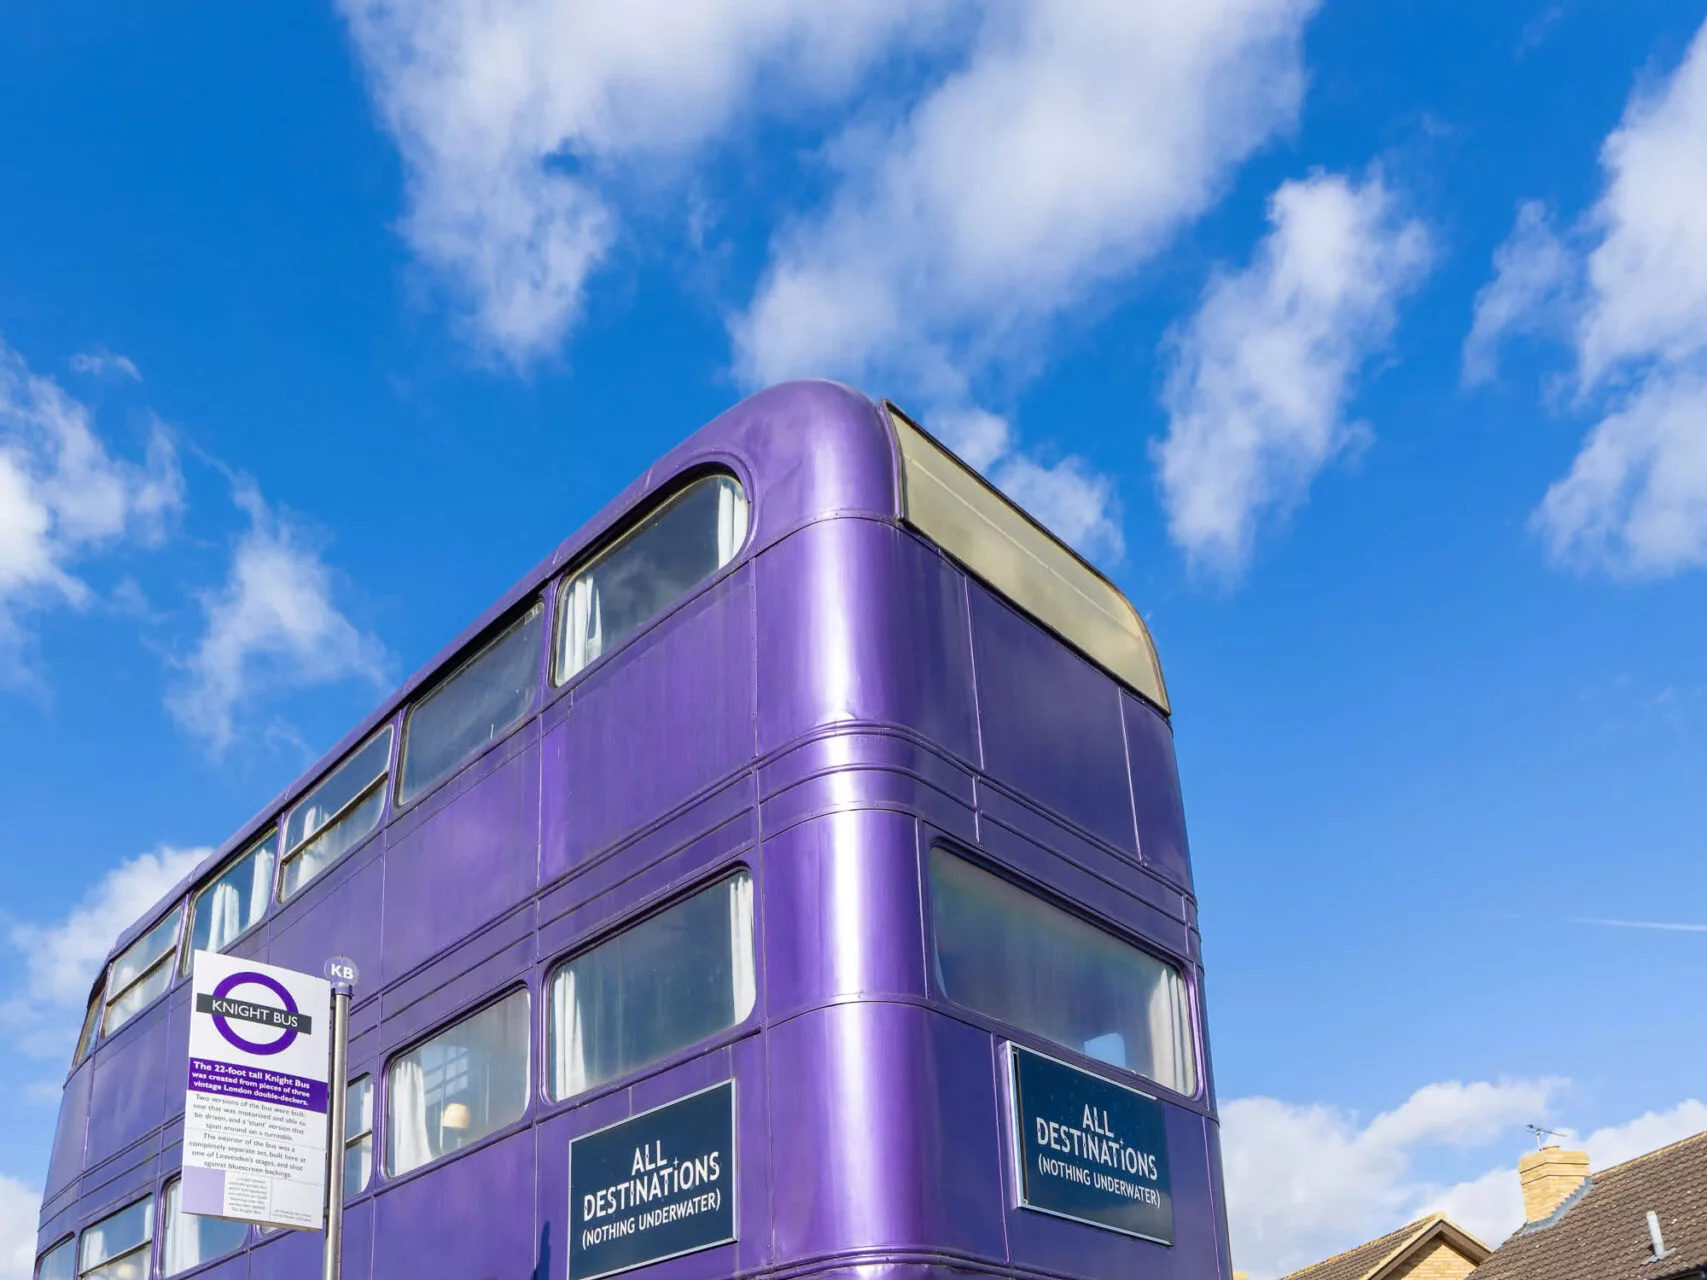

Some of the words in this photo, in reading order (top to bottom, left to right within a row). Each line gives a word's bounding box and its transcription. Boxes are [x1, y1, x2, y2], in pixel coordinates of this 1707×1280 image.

[331, 963, 354, 980] KB
[211, 999, 270, 1022] KNIGHT
[273, 1011, 298, 1028] BUS
[193, 1061, 212, 1071] The
[214, 1064, 247, 1077] 22-foot
[248, 1071, 263, 1080] tall
[265, 1073, 293, 1086] Knight
[295, 1079, 310, 1090] Bus
[208, 1074, 238, 1084] created
[239, 1078, 258, 1088] from
[259, 1082, 282, 1092] pieces
[291, 1089, 310, 1098] three
[193, 1080, 222, 1091] vintage
[223, 1084, 252, 1095] London
[253, 1090, 309, 1106] double-deckers.
[195, 1093, 210, 1102] Two
[211, 1097, 239, 1106] versions
[261, 1104, 273, 1112] bus
[269, 1124, 291, 1132] version
[292, 1127, 304, 1135] that
[1082, 1103, 1114, 1138] ALL
[189, 1140, 225, 1151] completely
[228, 1146, 256, 1155] separate
[269, 1151, 283, 1159] built
[284, 1153, 299, 1162] here
[204, 1132, 216, 1140] The
[217, 1135, 244, 1144] interior
[265, 1141, 277, 1149] bus
[1036, 1116, 1158, 1181] DESTINATIONS
[204, 1160, 227, 1169] against
[631, 1139, 668, 1176] ALL
[583, 1151, 720, 1222] DESTINATIONS
[1038, 1153, 1091, 1186] (NOTHING
[1093, 1171, 1160, 1209] UNDERWATER)
[582, 1217, 635, 1250] (NOTHING
[638, 1188, 721, 1231] UNDERWATER)
